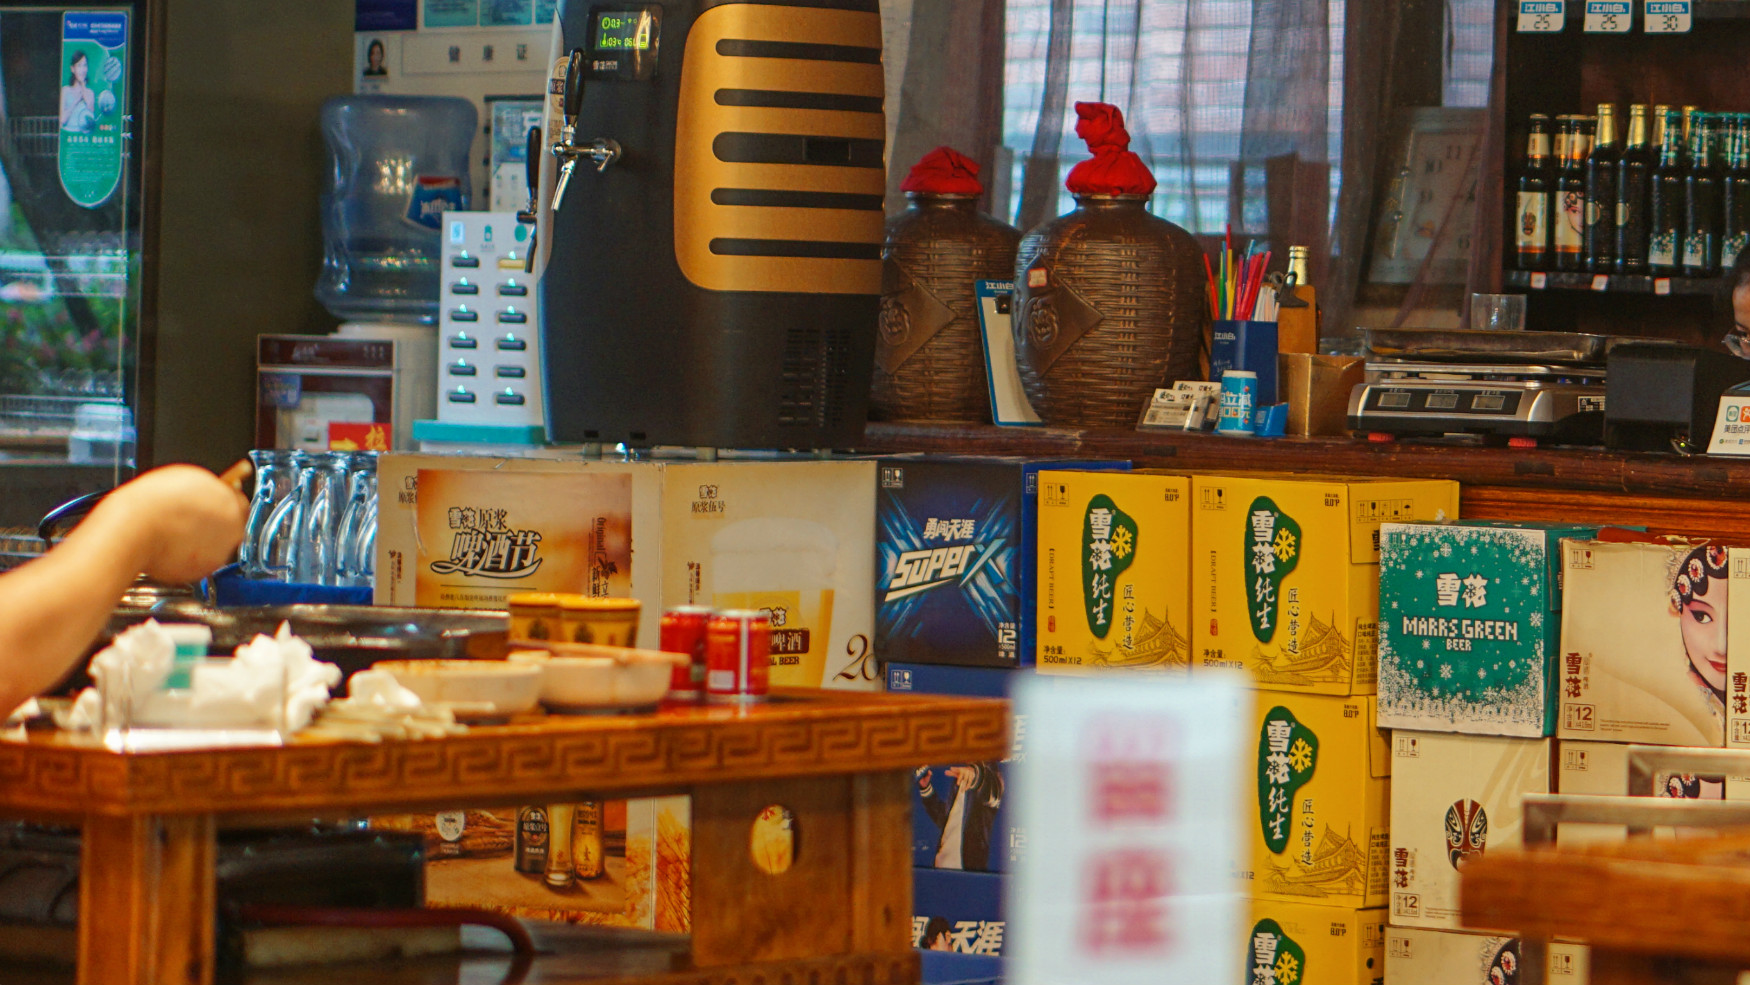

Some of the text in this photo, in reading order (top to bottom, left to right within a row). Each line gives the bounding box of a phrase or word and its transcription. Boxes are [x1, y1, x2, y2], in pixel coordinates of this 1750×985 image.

[1525, 2, 1559, 13] 江小白
[1534, 15, 1550, 30] 25
[1600, 15, 1618, 30] 25
[448, 529, 544, 570] 啤酒节
[923, 517, 976, 542] 勇闯天涯
[1089, 507, 1113, 626] 雪花纯生
[1251, 509, 1276, 630] 雪花纯生
[1436, 572, 1489, 609] 雪花
[997, 629, 1017, 644] 12
[1122, 583, 1135, 651] 匠心营造
[1287, 587, 1301, 655] 匠心营造
[1402, 615, 1518, 641] MARRS GREEN
[1445, 638, 1473, 652] BEER
[1565, 651, 1583, 698] 雪花
[1731, 671, 1748, 715] 雪花
[1574, 706, 1593, 722] 12
[1266, 719, 1292, 841] 雪花纯生
[1300, 798, 1315, 867] 匠心营造
[1393, 847, 1409, 889] 雪花
